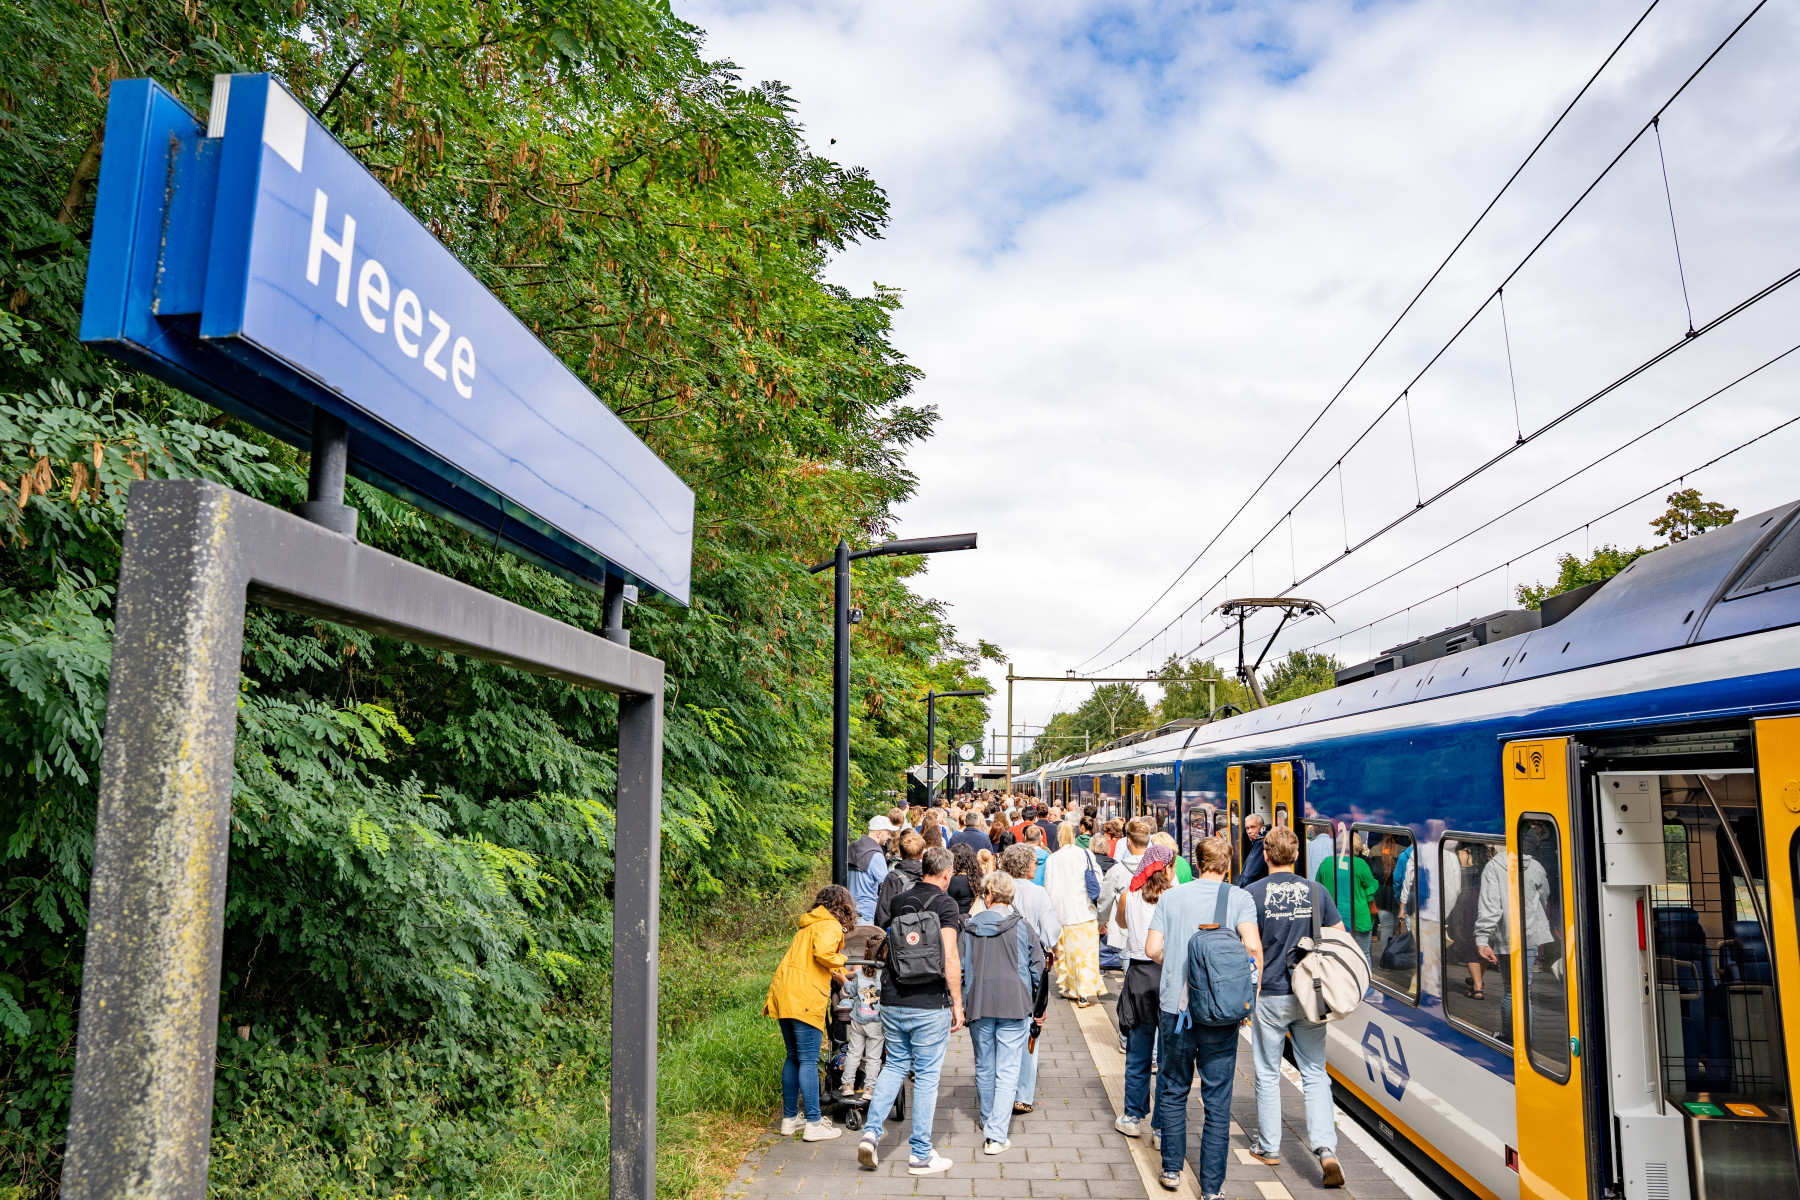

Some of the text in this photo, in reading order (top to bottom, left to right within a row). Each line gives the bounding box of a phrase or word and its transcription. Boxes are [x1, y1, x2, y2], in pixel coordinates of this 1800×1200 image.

[306, 187, 476, 399] Heeze
[964, 767, 970, 775] 2
[1337, 821, 1349, 871] 2
